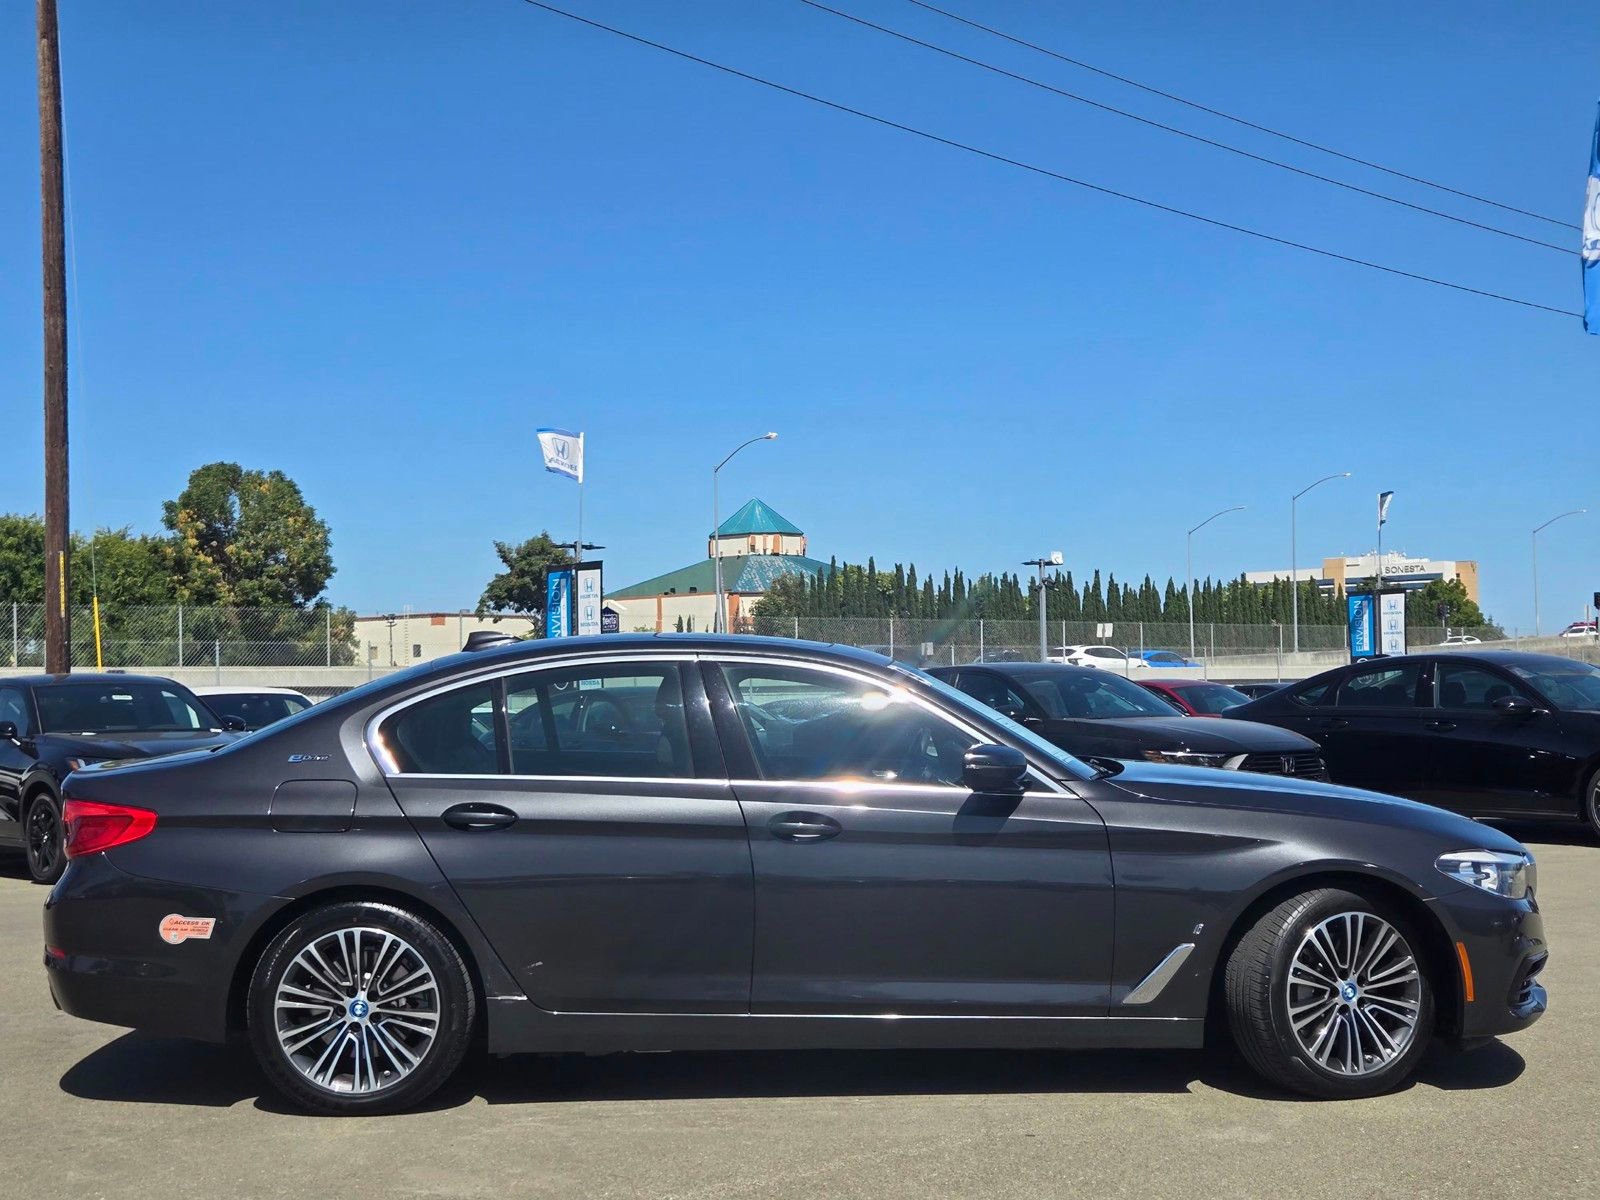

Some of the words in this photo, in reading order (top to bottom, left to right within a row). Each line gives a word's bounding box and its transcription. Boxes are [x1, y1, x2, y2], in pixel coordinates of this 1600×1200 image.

[1385, 565, 1426, 574] SONESTA
[552, 578, 561, 637] NVISION
[1354, 600, 1363, 651] ENVISION
